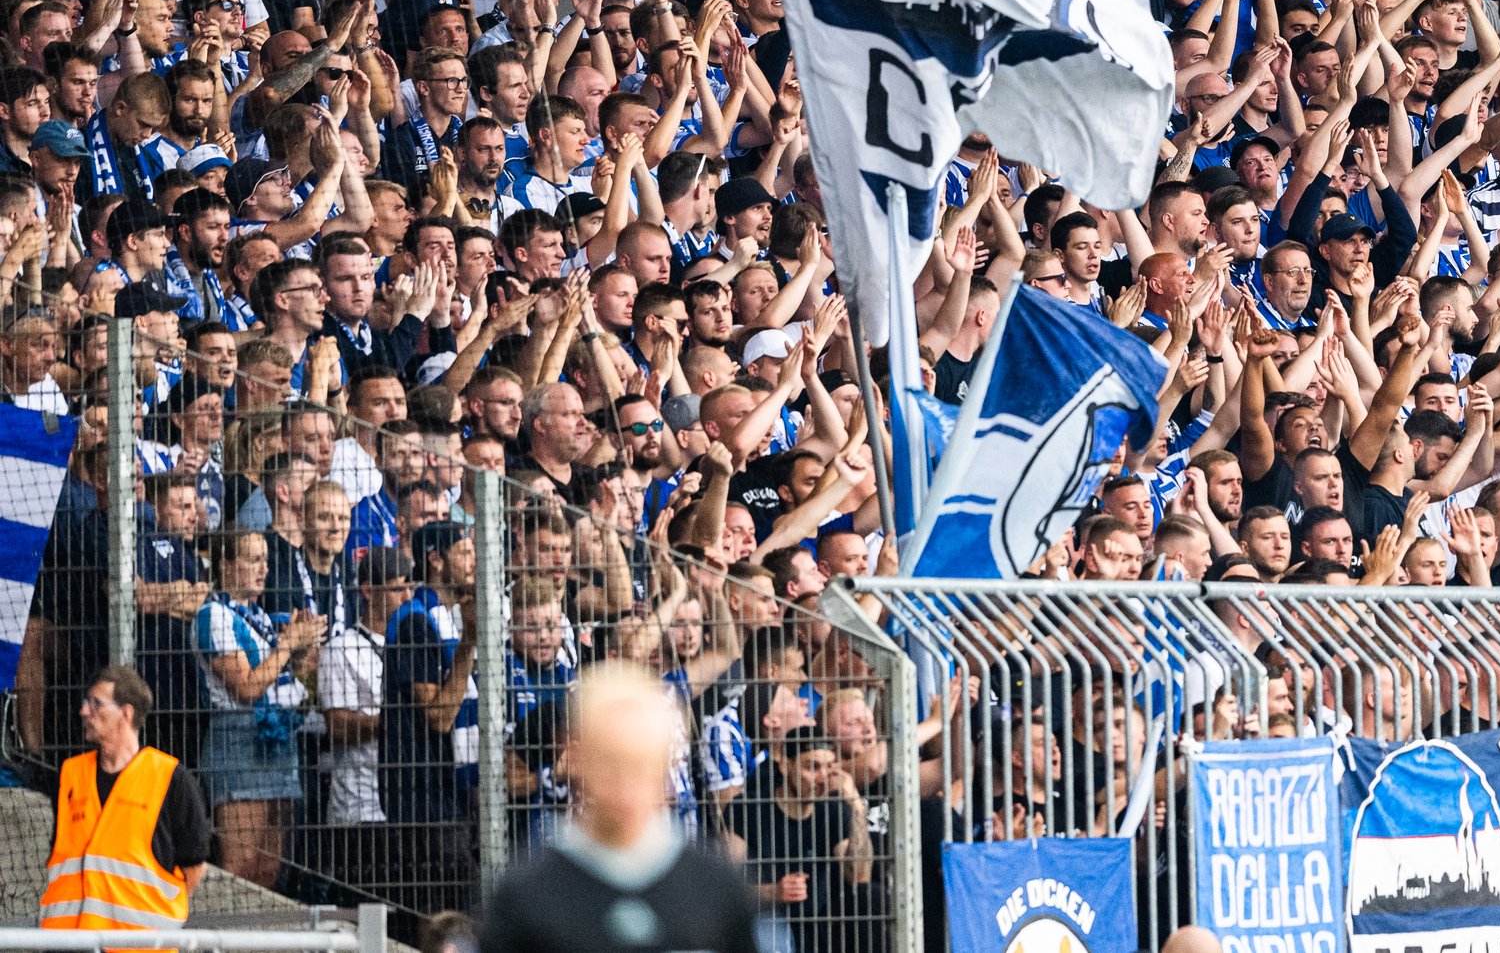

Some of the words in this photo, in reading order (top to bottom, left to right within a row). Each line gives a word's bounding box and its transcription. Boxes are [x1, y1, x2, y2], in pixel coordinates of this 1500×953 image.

[1209, 764, 1327, 848] RAGAZZI
[996, 886, 1024, 937] DIE
[1212, 848, 1331, 928] DELLA
